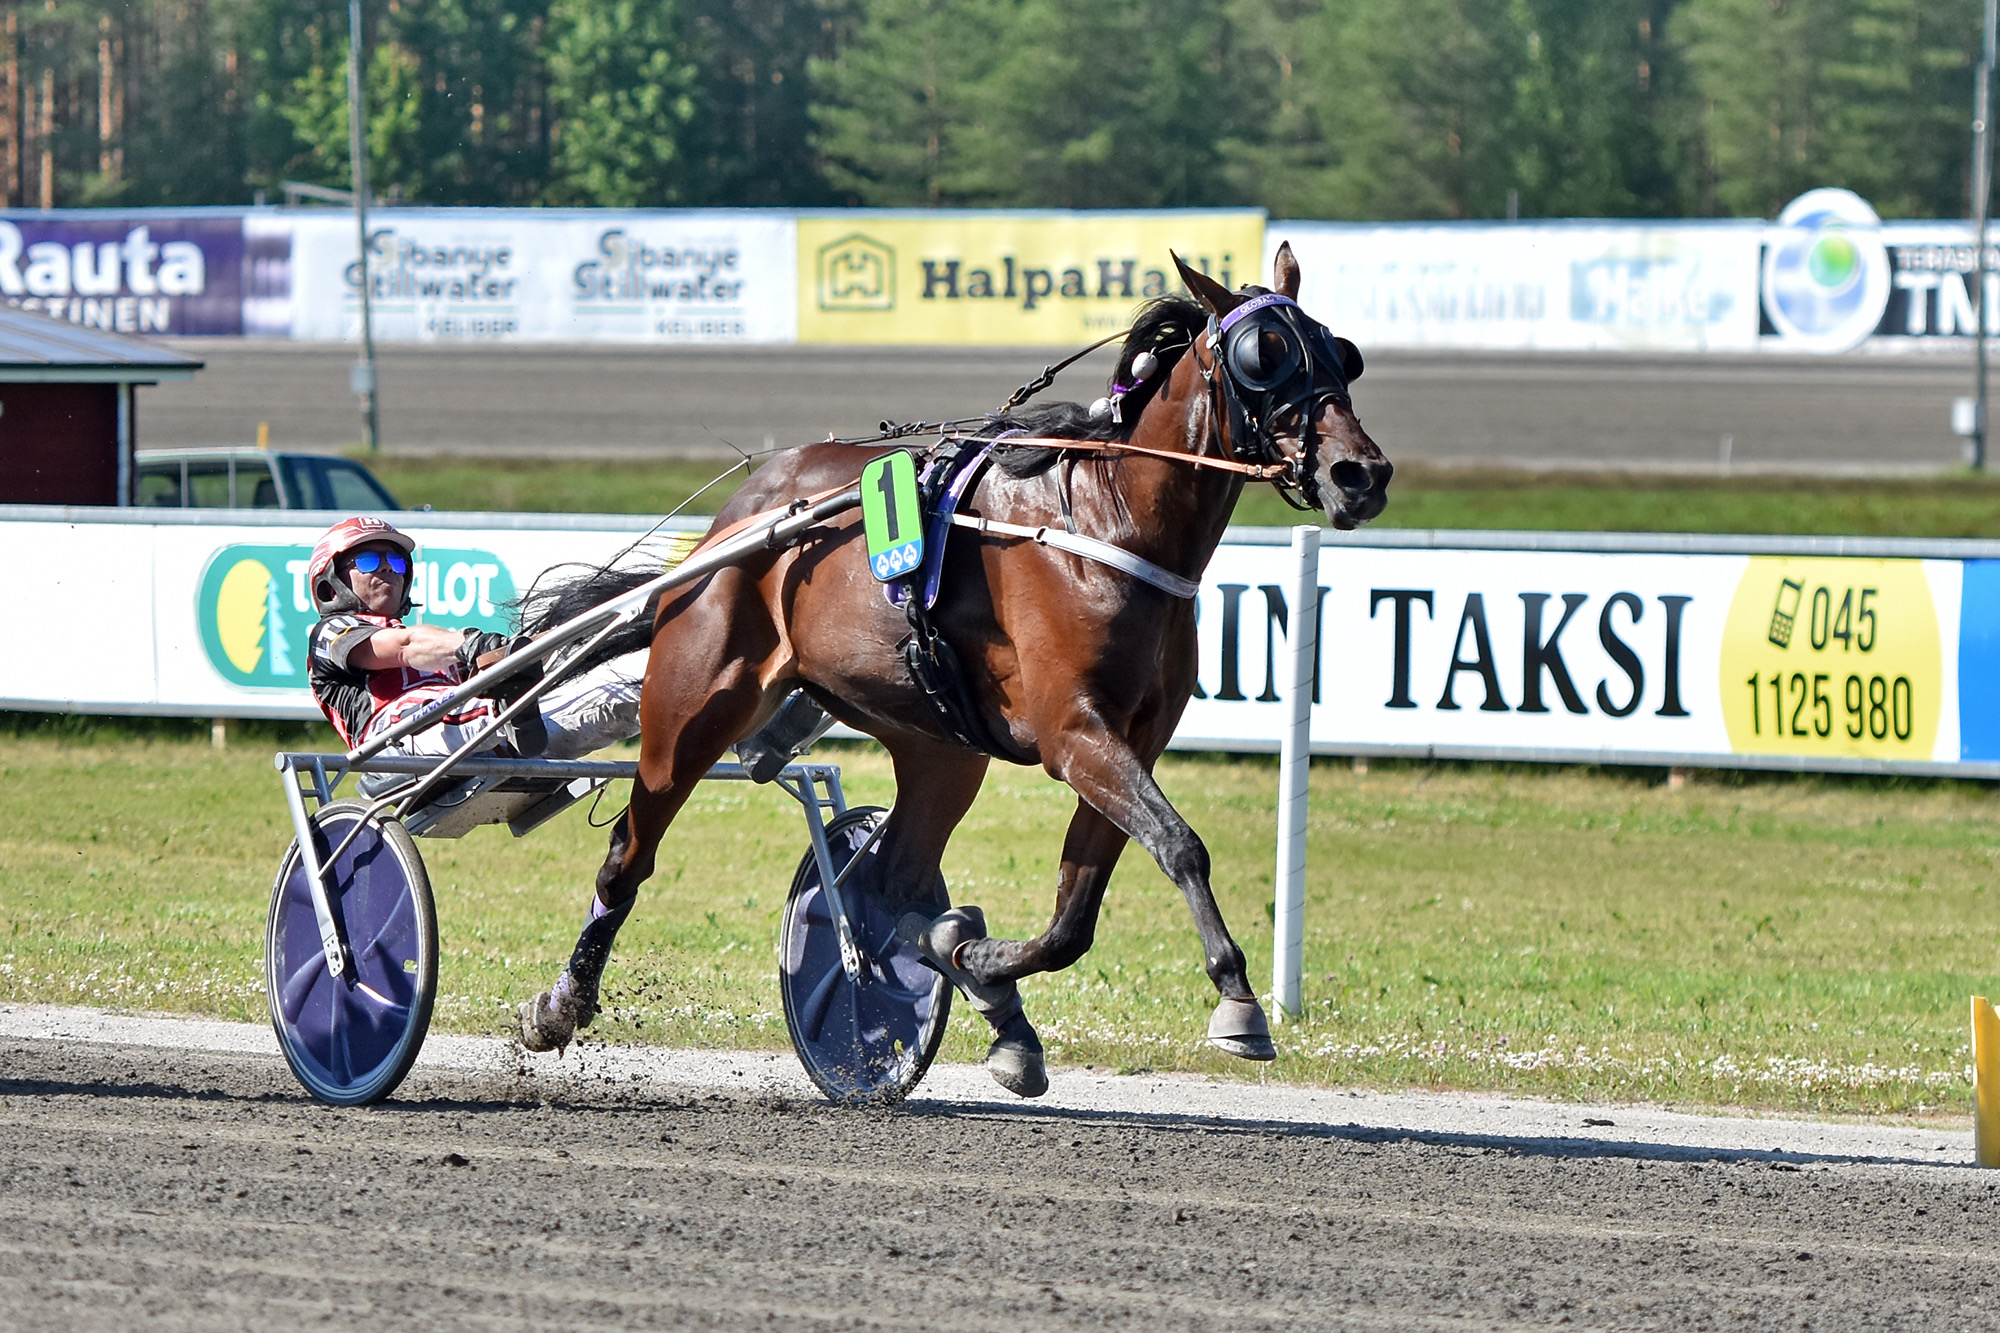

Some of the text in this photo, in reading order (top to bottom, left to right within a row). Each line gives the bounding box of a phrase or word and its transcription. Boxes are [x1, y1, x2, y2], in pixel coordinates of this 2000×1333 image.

[370, 229, 512, 275] Sibanye
[600, 229, 739, 275] Sibanye
[343, 262, 517, 300] Stillwater
[574, 262, 745, 300] Stillwater
[877, 460, 900, 542] 1
[1810, 586, 1878, 652] 045
[1370, 588, 1694, 718] TAKSI
[1747, 672, 1912, 740] 1125 980
